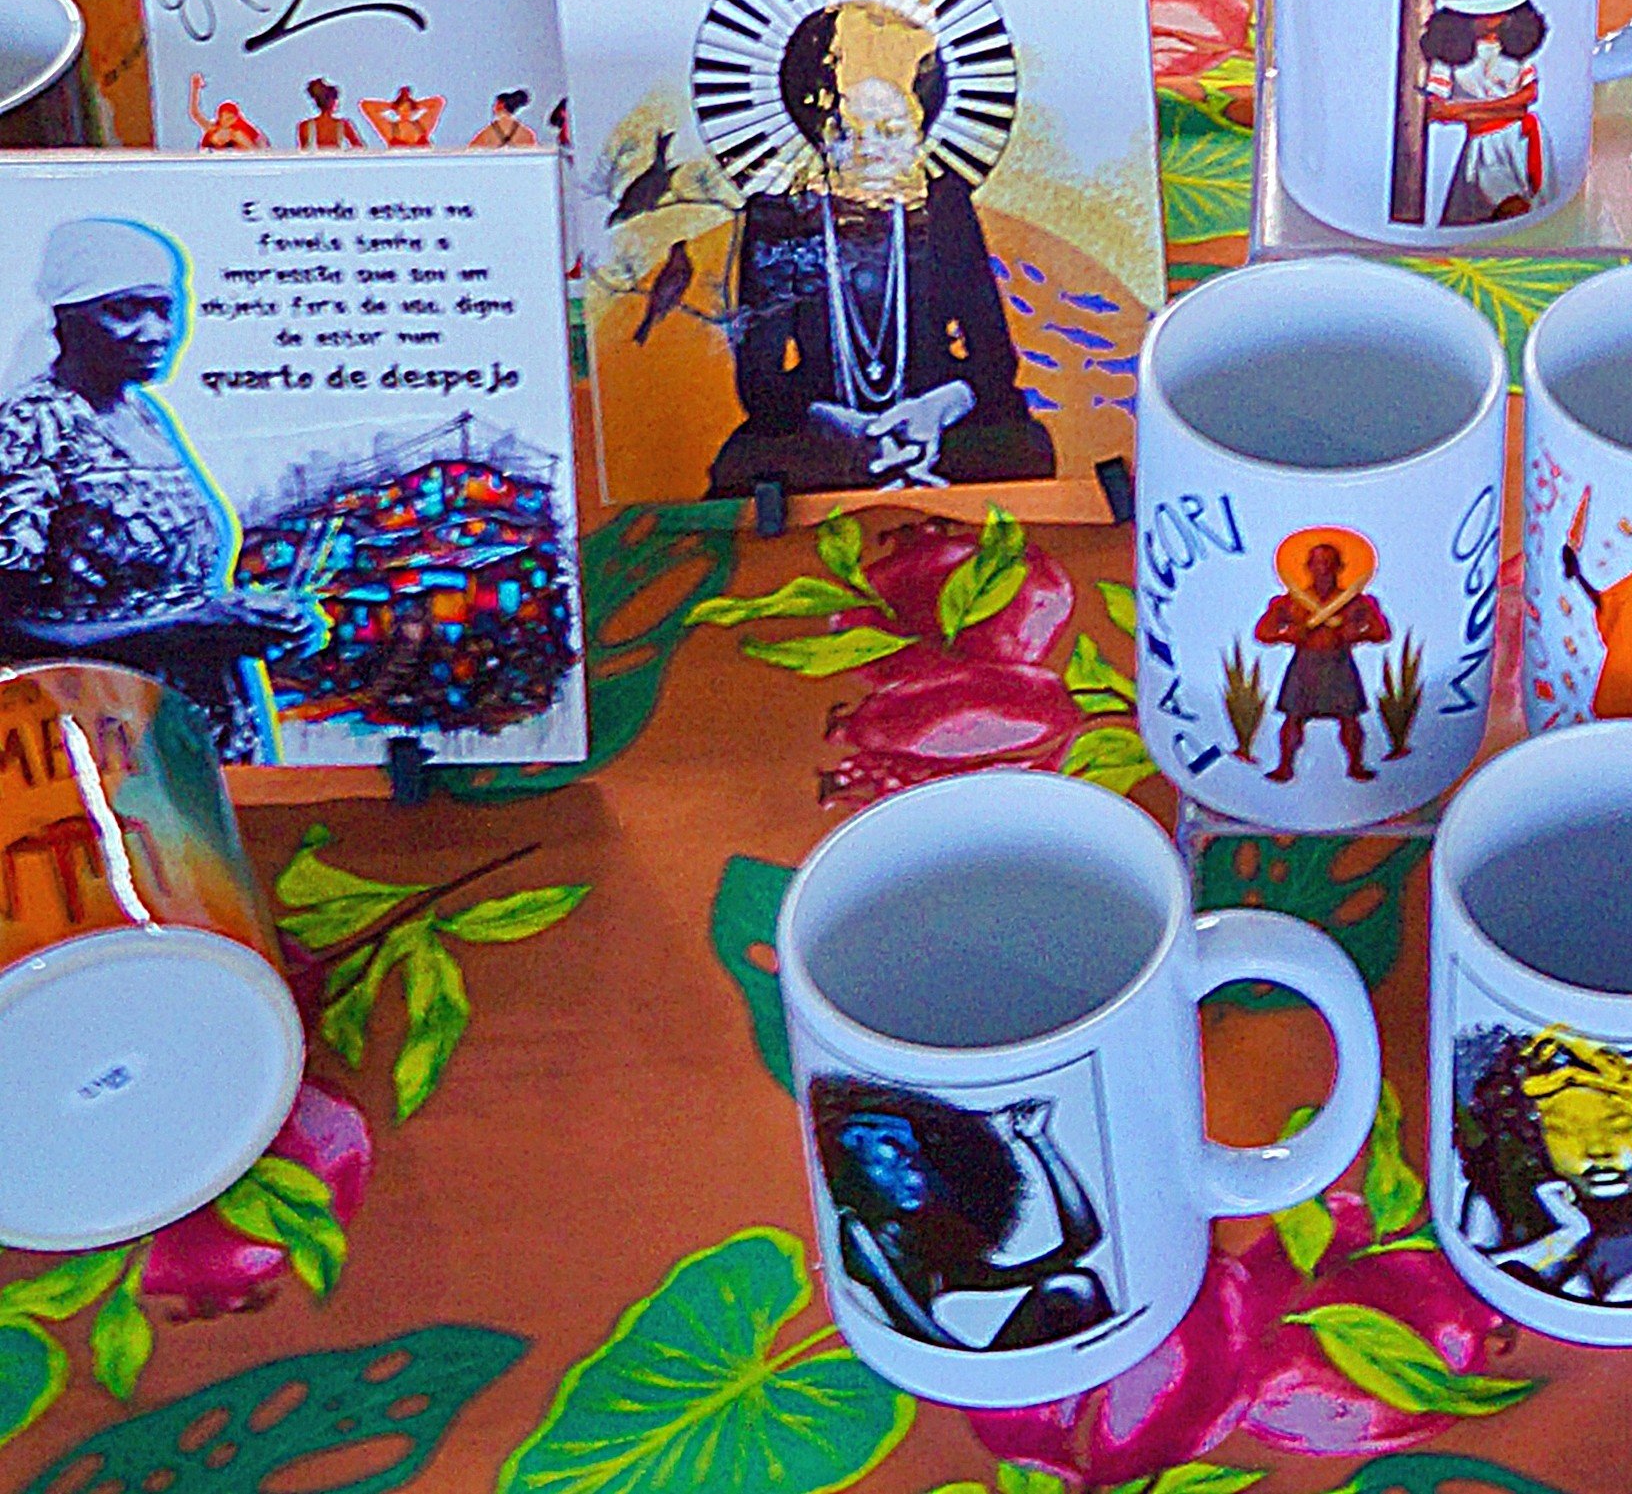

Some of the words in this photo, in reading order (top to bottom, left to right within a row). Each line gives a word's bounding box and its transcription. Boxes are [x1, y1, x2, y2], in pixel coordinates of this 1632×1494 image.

[201, 363, 313, 396] quarto
[327, 363, 367, 389] de
[380, 362, 519, 396] despejo
